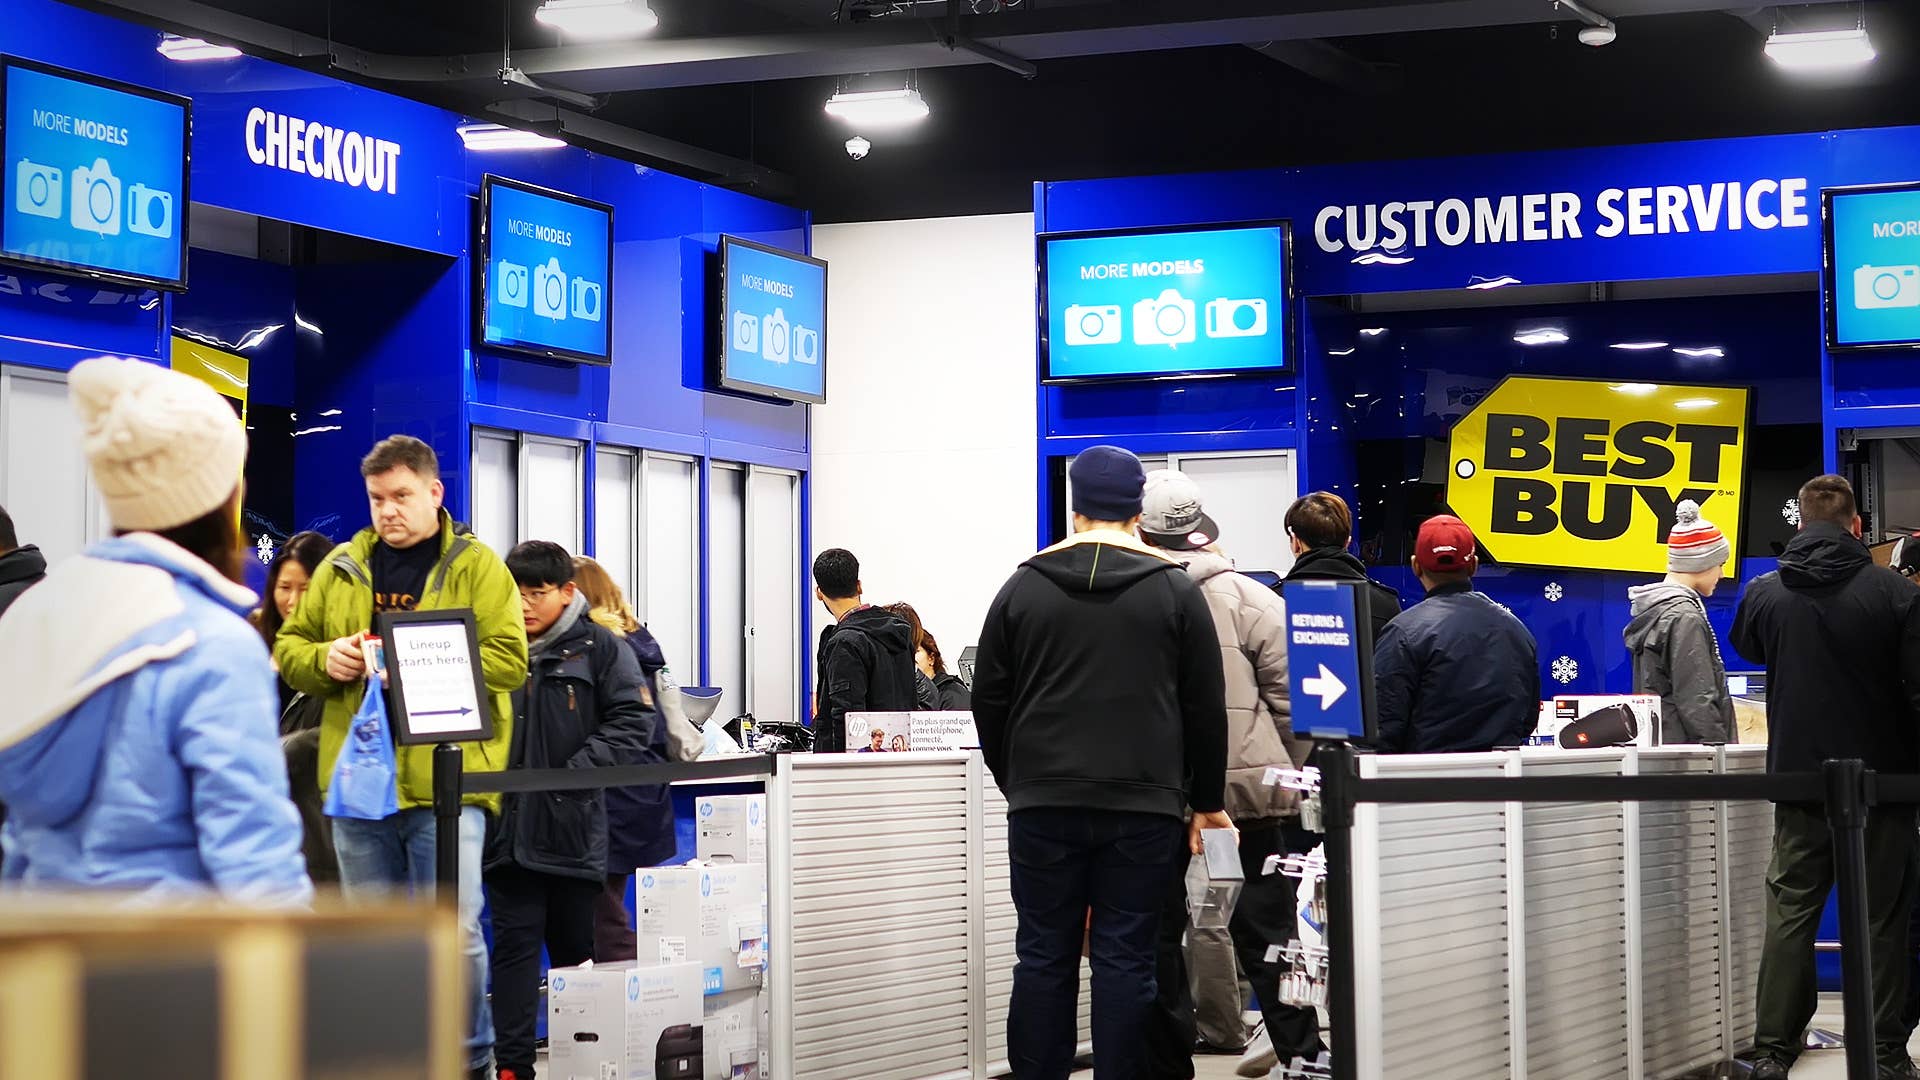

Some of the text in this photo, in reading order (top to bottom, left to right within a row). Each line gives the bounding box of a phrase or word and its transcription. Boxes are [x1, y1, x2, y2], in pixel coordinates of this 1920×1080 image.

[33, 109, 128, 146] MORE MODELS
[245, 107, 400, 194] CHECKOUT
[1314, 177, 1809, 253] CUSTOMER SERVICE
[508, 219, 572, 247] MORE MODELS
[1873, 221, 1920, 238] MOR
[1080, 259, 1204, 280] MORE MODELS
[742, 273, 794, 298] MORE MODELS
[1483, 413, 1739, 483] BEST
[1490, 476, 1716, 545] BUY
[1291, 614, 1344, 628] RETURNS &
[410, 639, 451, 651] Lineup
[1293, 631, 1350, 646] EXCHANGES
[399, 655, 469, 667] starts here.
[850, 717, 867, 737] hp
[912, 727, 930, 735] votre
[924, 717, 938, 727] plus
[939, 717, 958, 727] grand
[959, 718, 972, 726] que
